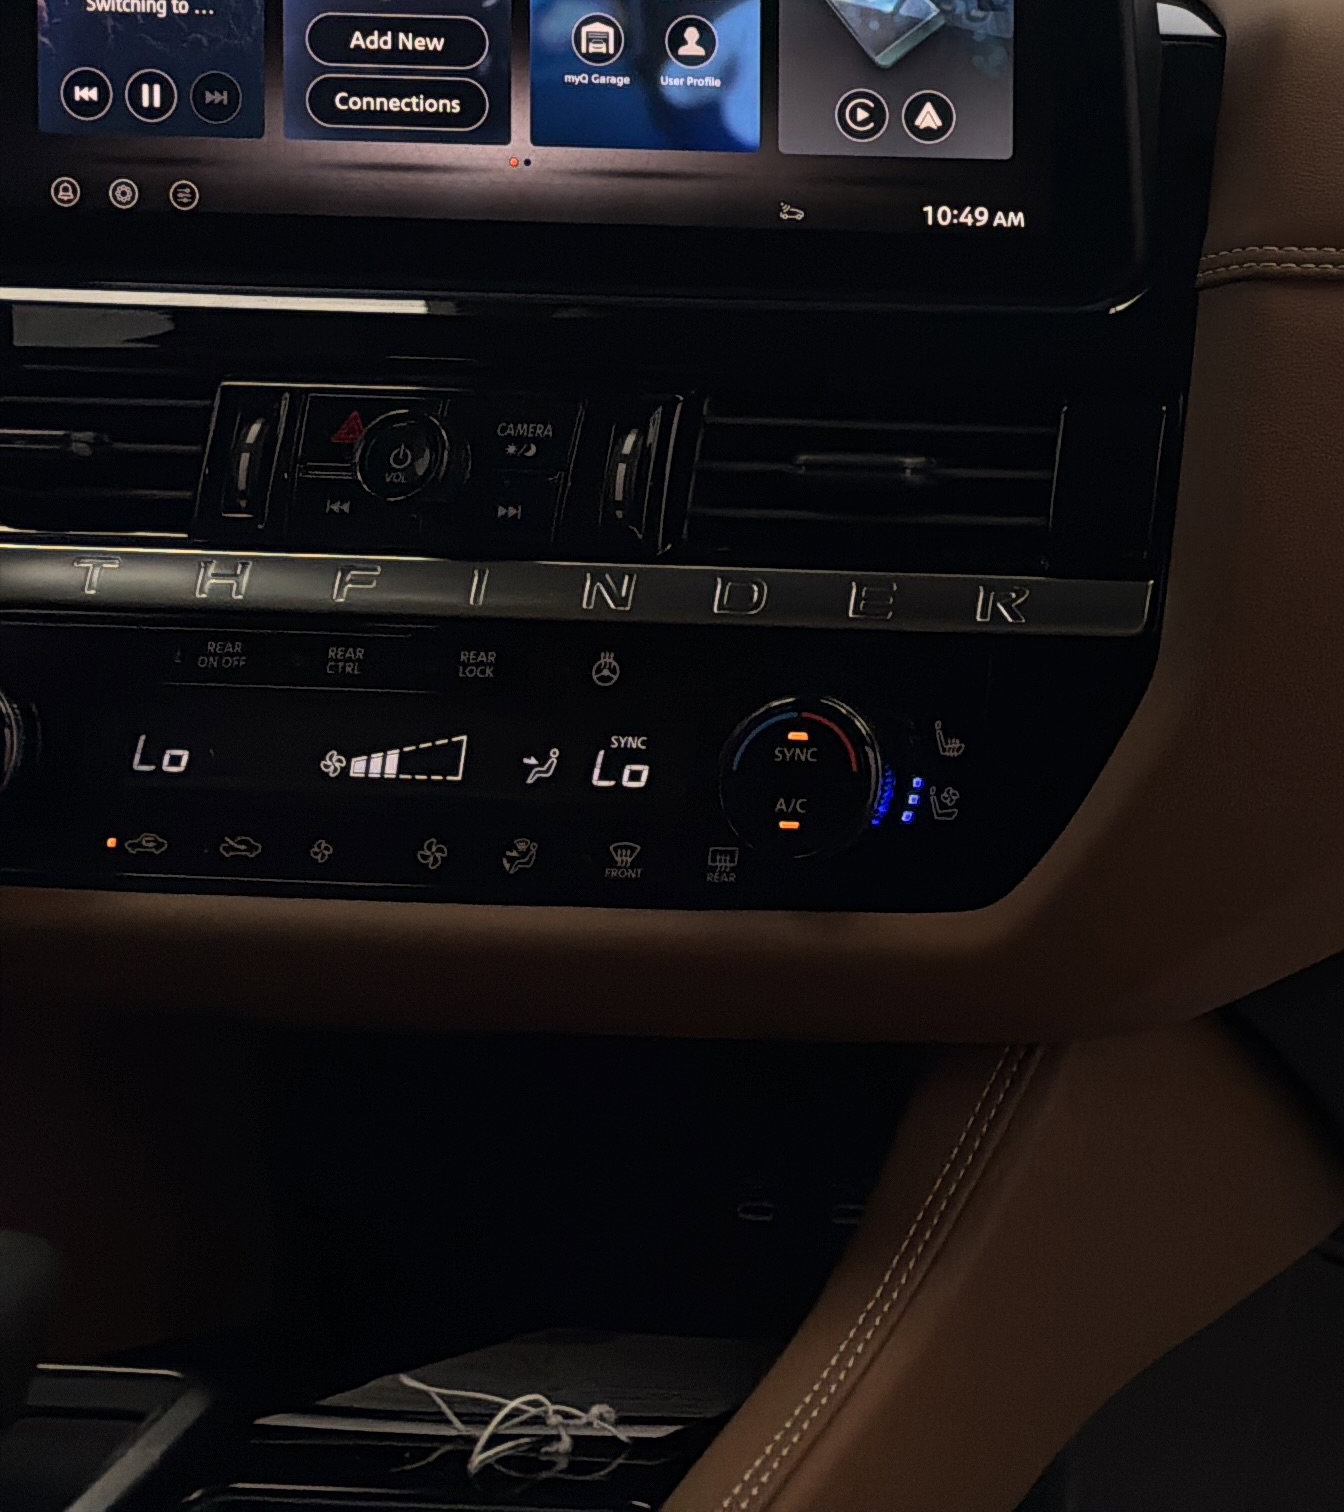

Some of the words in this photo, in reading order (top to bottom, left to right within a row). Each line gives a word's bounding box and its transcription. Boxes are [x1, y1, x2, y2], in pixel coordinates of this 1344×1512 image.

[350, 31, 391, 50] Add
[397, 33, 445, 52] New
[564, 73, 589, 86] myQ
[591, 73, 631, 87] Garage
[660, 75, 684, 87] User
[687, 76, 722, 88] Profile
[334, 92, 461, 113] Connections
[922, 205, 989, 227] 10:49
[993, 211, 1026, 228] AM
[496, 422, 553, 438] CAMERA
[384, 472, 407, 483] VOL
[207, 641, 244, 654] REAR
[327, 646, 365, 661] REAR
[197, 656, 221, 669] ON
[222, 656, 248, 669] OFF
[459, 650, 497, 664] REAR
[326, 661, 362, 675] CTRL
[458, 665, 495, 678] LOCK
[610, 735, 648, 750] SYNC
[132, 734, 190, 772] Lo
[773, 747, 818, 762] SYNC
[591, 748, 650, 788] Lo
[774, 798, 808, 813] A/C
[604, 868, 642, 879] FRONT
[705, 872, 737, 883] REAR
